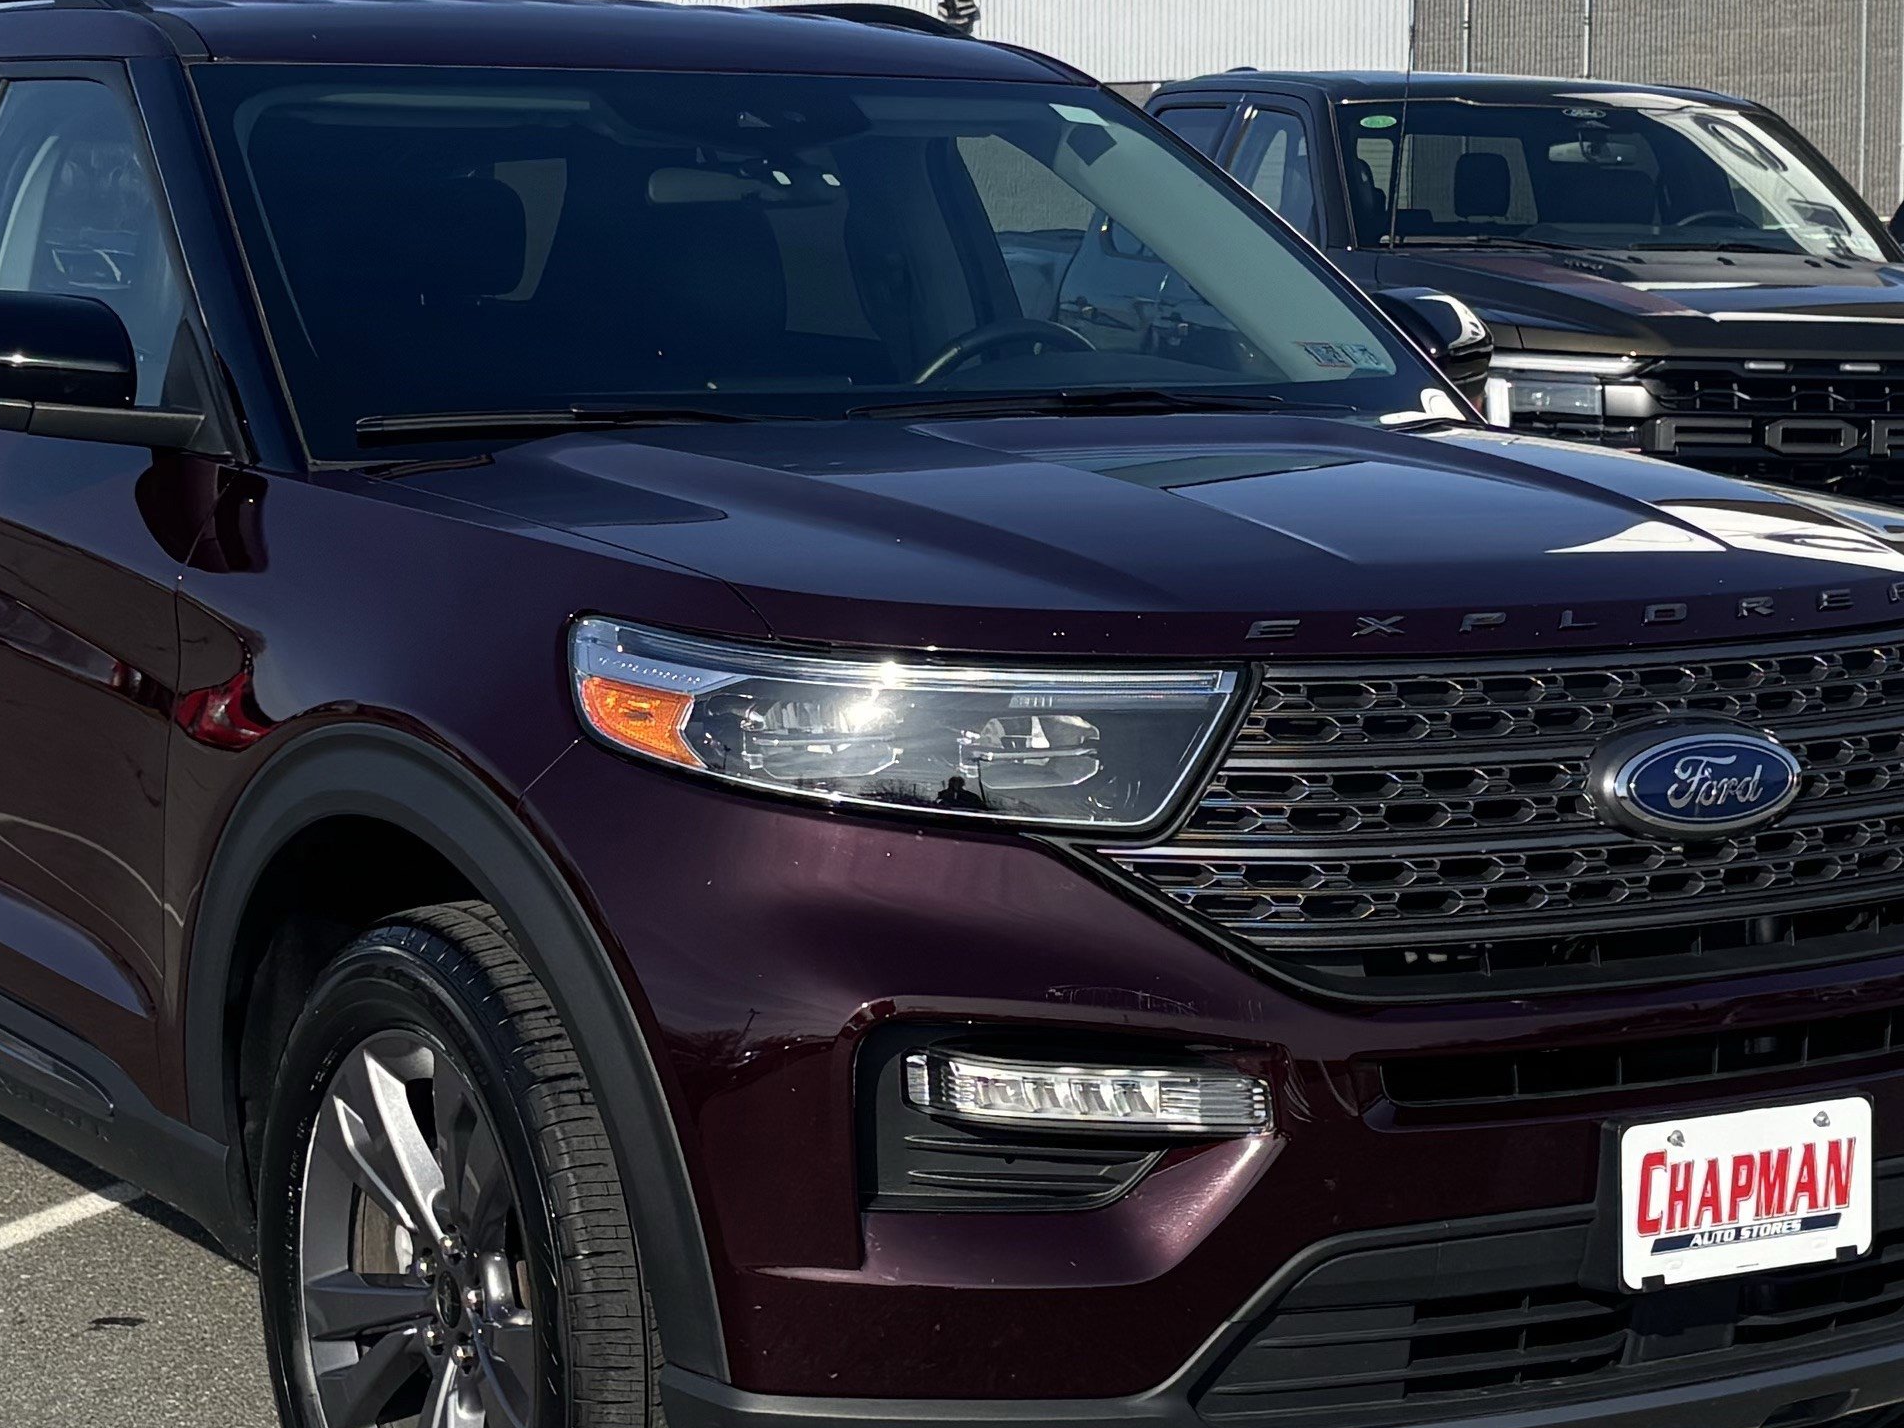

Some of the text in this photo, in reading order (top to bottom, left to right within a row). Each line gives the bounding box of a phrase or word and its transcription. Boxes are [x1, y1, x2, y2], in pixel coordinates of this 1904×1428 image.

[1666, 754, 1764, 810] Ford
[1636, 1136, 1857, 1238] CHAPMAN
[1689, 1219, 1803, 1249] AUTO STORES
